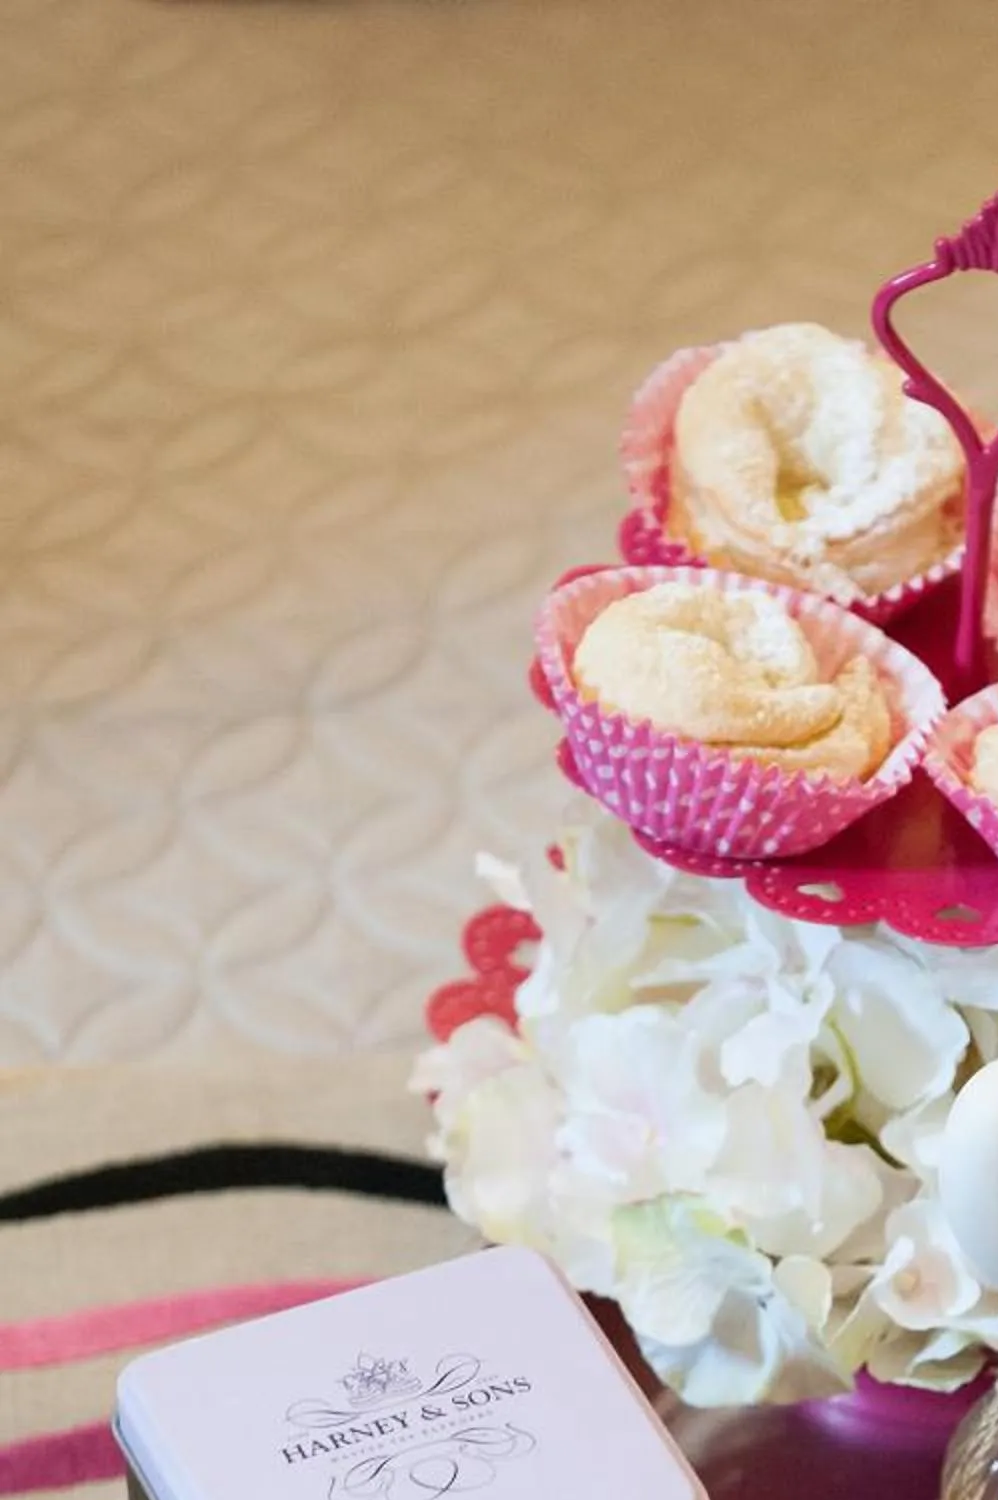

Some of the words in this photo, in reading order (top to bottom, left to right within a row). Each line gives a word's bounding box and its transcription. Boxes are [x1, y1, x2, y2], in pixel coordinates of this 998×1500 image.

[281, 1411, 410, 1465] HARNEY
[420, 1404, 448, 1421] &
[451, 1376, 533, 1411] SONS
